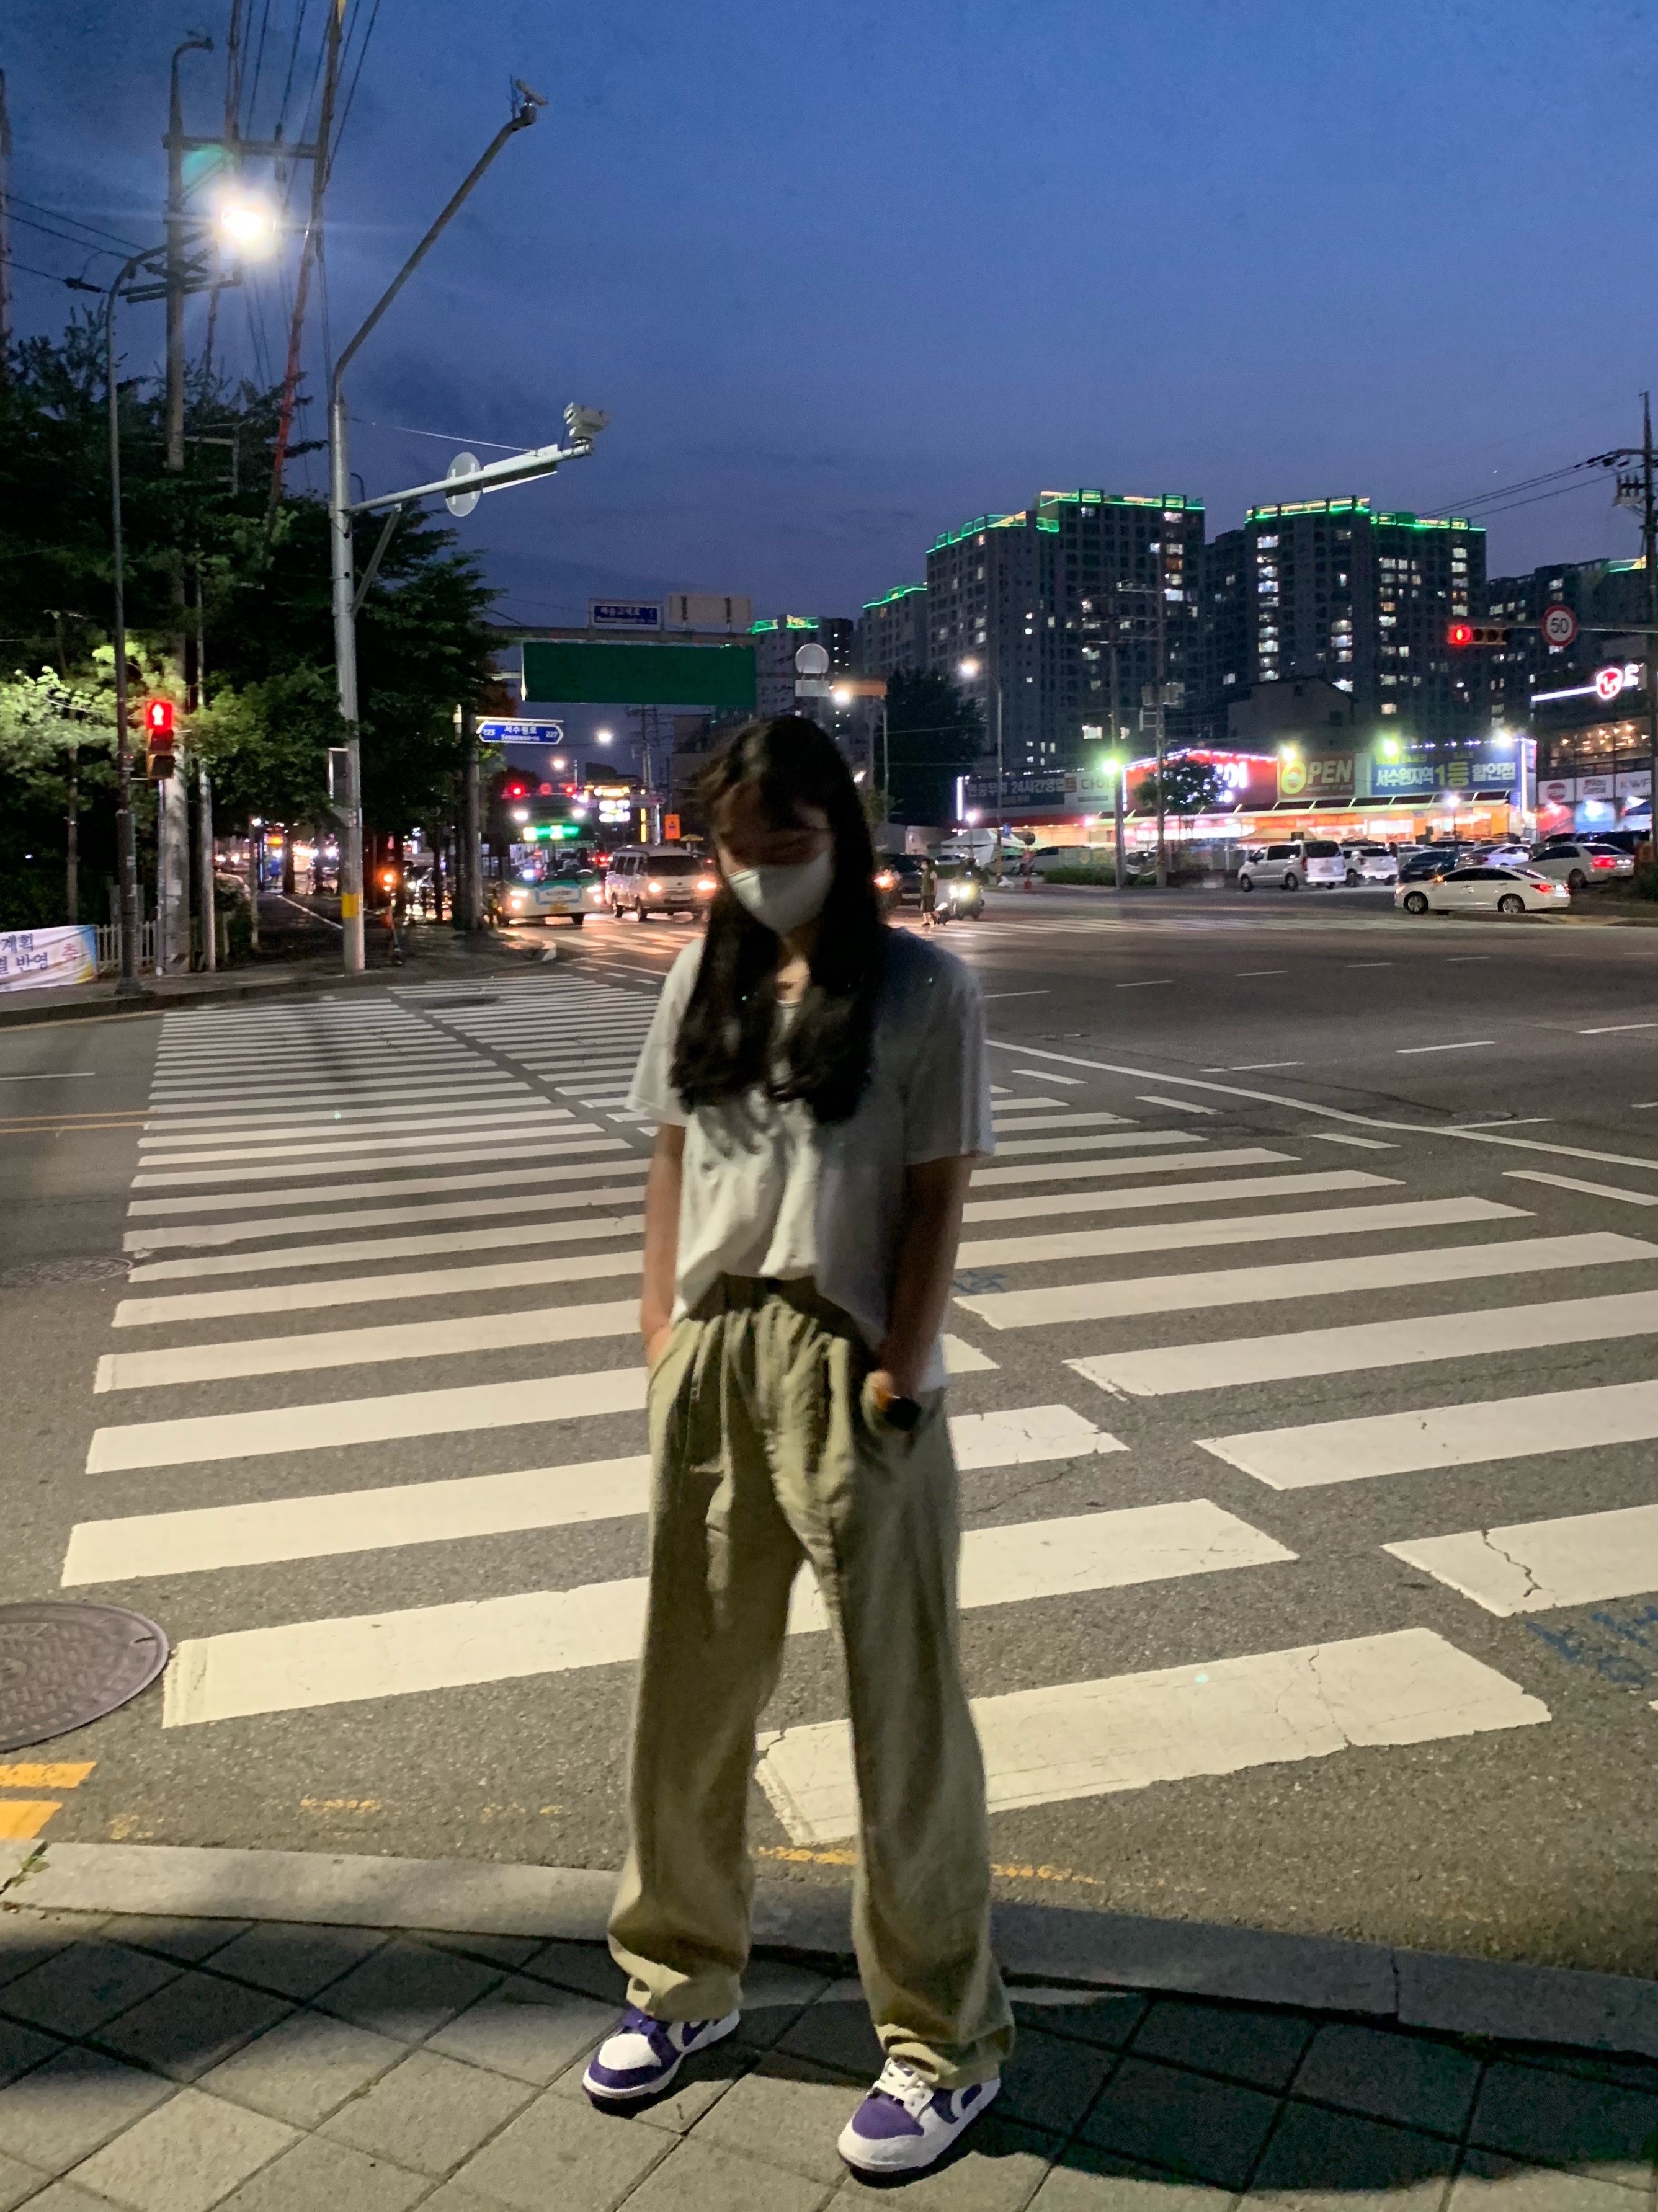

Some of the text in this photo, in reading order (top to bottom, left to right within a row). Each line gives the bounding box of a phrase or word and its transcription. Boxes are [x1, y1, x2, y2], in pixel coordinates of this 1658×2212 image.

[1551, 617, 1569, 634] 50
[504, 726, 537, 735] 서수원로
[1281, 759, 1353, 794] OPEN
[1376, 761, 1516, 788] 서수원지역 1등 할인점
[1, 933, 34, 953] 계획
[16, 952, 48, 972] 반영
